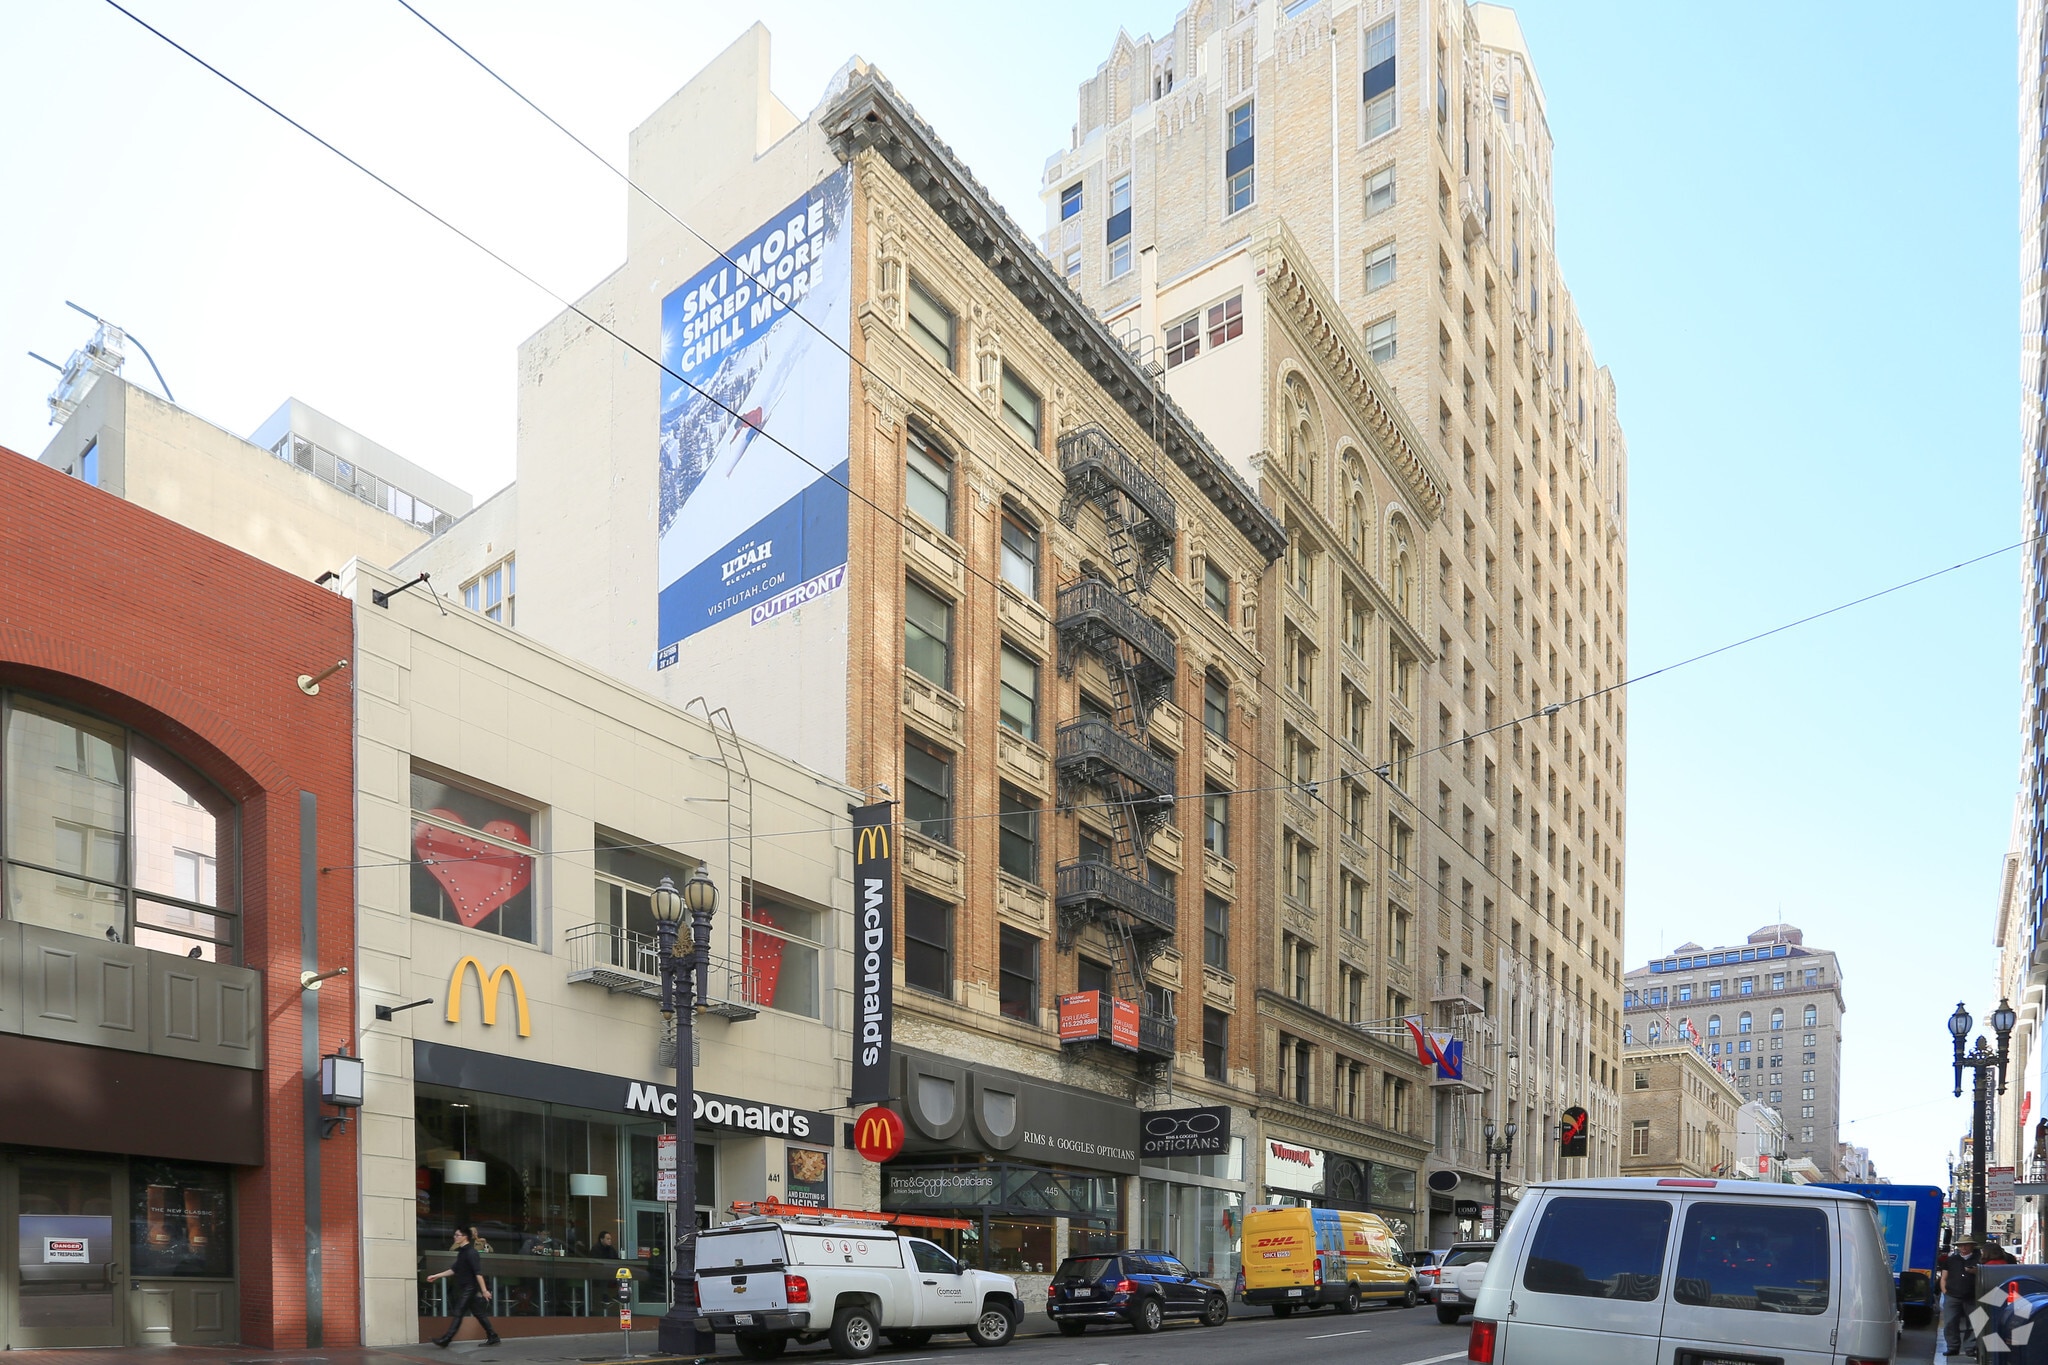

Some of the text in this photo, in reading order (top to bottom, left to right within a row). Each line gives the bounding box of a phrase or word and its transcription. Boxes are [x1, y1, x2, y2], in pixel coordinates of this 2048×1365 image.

[682, 198, 825, 323] SKI MORE
[682, 232, 824, 347] SHRED MORE
[681, 259, 823, 373] CHILL MORE
[737, 541, 755, 553] LIFE
[721, 540, 773, 582] UTAH
[726, 562, 767, 587] ELEVATED
[707, 572, 785, 617] VISITUTAH.COM
[753, 569, 842, 624] OUTFRONT
[863, 878, 884, 1067] McDonald's
[1074, 1012, 1090, 1020] LEASE
[626, 1082, 810, 1137] McDonald's
[1985, 1100, 1993, 1151] CARTWRIGHT
[1024, 1131, 1135, 1161] RIMS & GOGGLES OPTICIANS
[1145, 1137, 1220, 1152] OPTICIANS
[768, 1173, 780, 1183] 441
[952, 1175, 993, 1188] Opticians
[1045, 1186, 1058, 1196] 445
[799, 1192, 820, 1200] EXCITING
[1258, 1236, 1296, 1247] DHL
[937, 1287, 961, 1297] comcast
